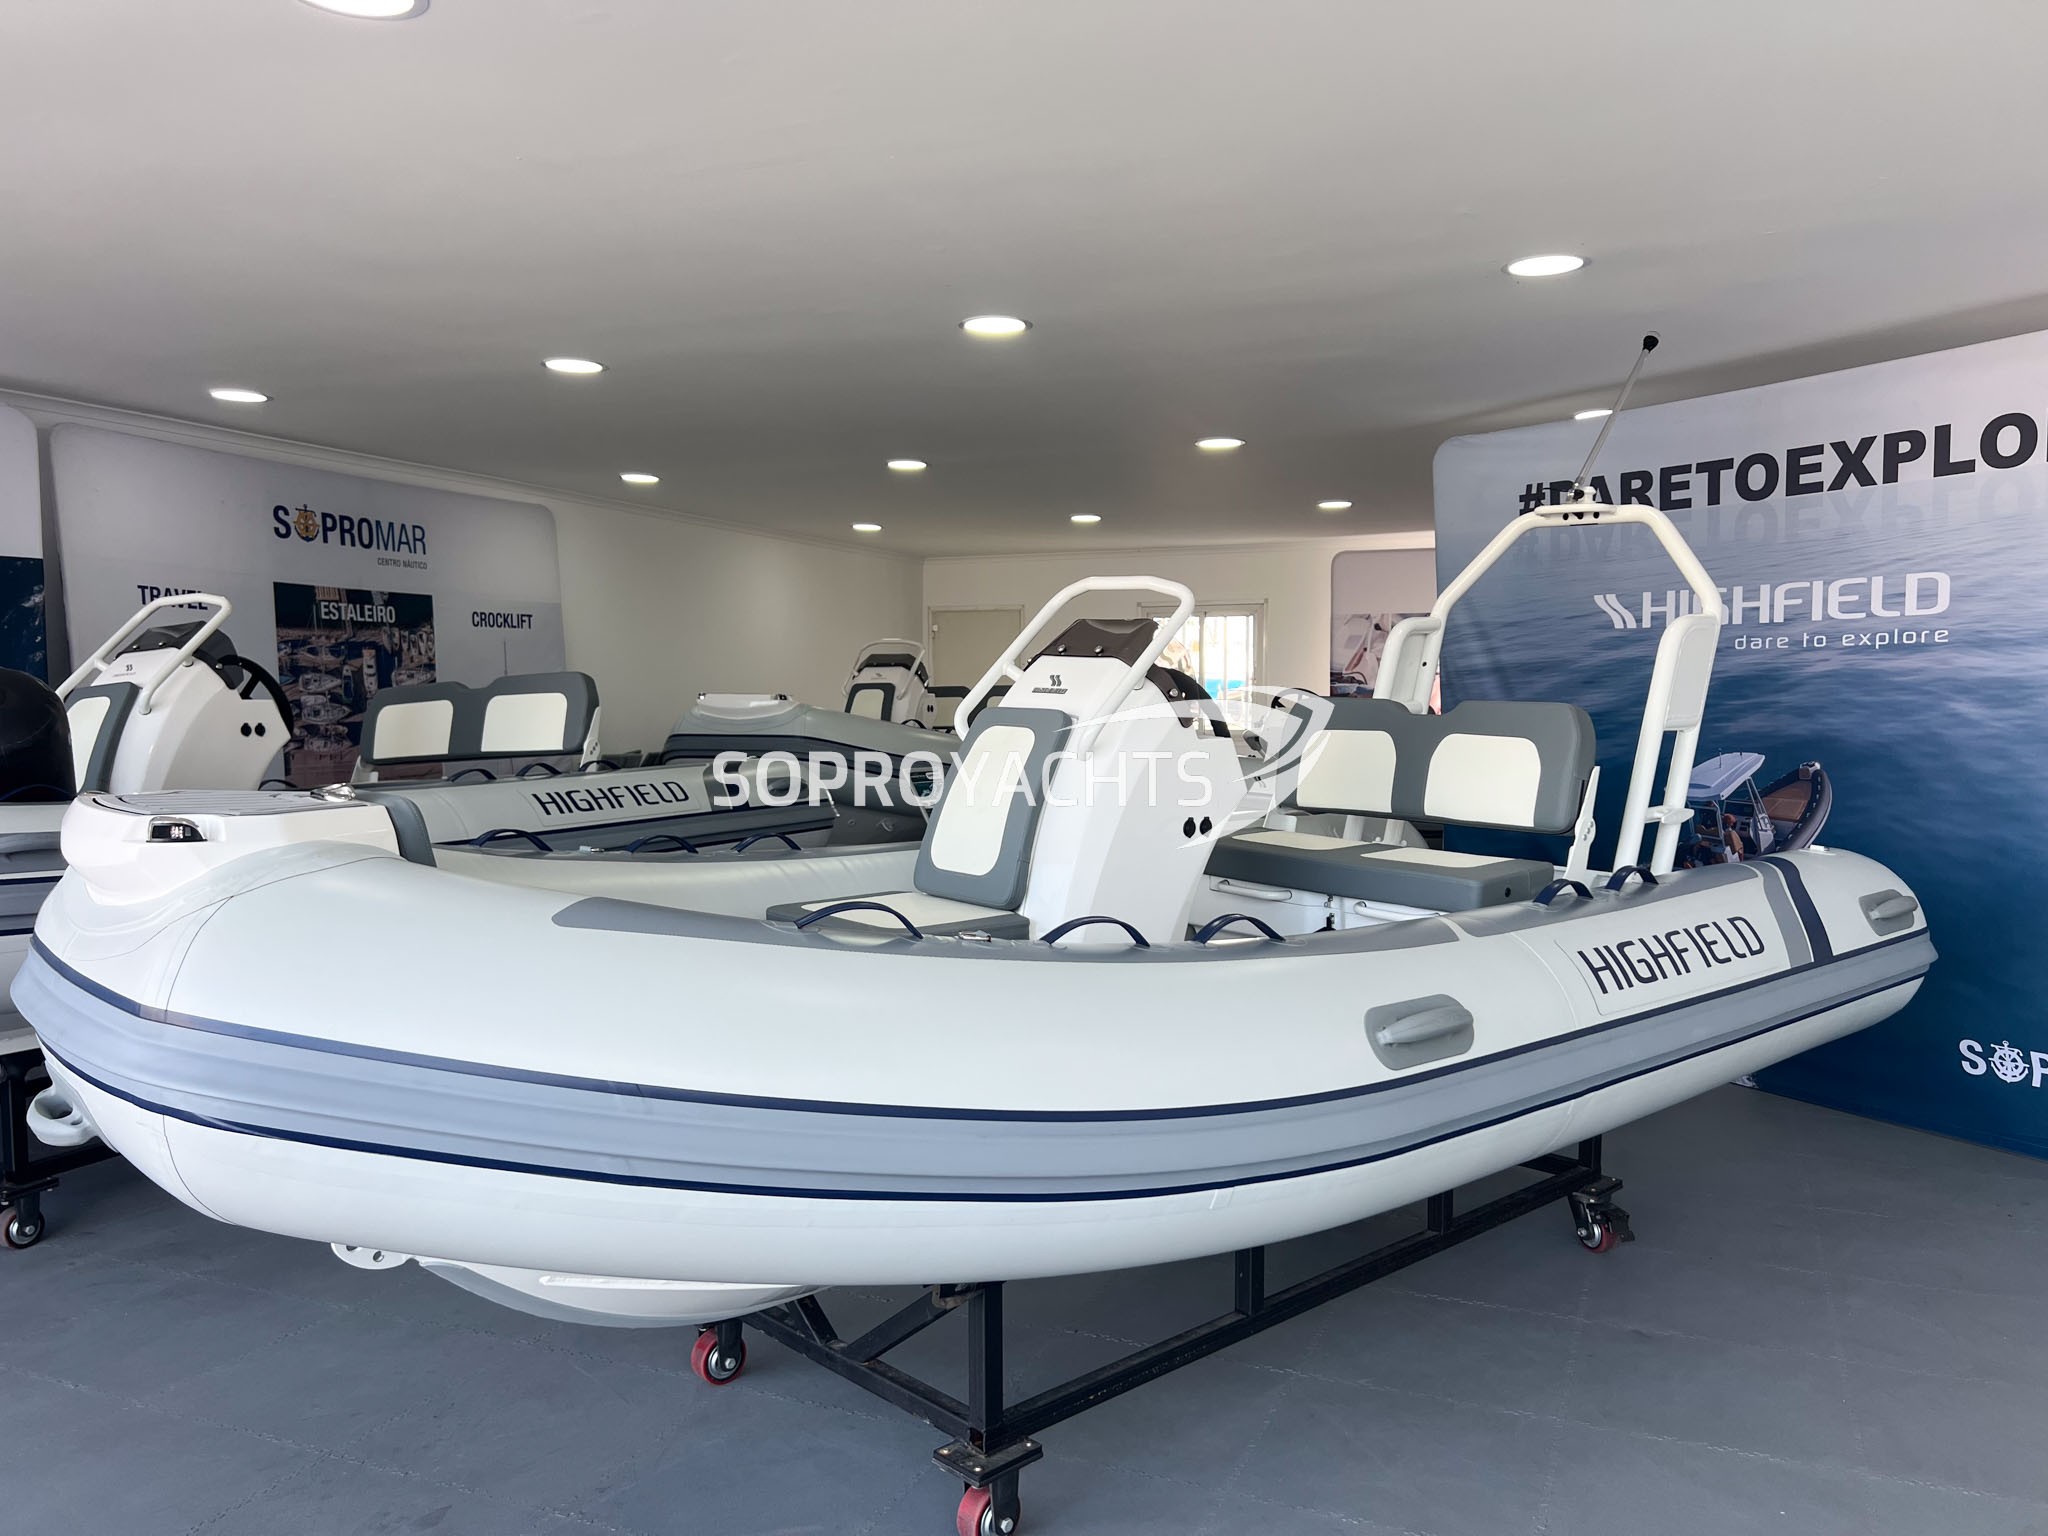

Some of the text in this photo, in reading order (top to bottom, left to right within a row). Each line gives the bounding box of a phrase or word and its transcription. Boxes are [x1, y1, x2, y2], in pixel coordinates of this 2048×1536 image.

[1519, 412, 2048, 515] #DARETOEXPLO
[377, 557, 401, 568] CENTRO
[320, 602, 396, 624] ESTALEIRO
[471, 611, 533, 630] CROCKLIFT
[1734, 628, 1950, 650] dare to explore
[532, 781, 690, 816] HIGHFIELD
[1577, 916, 1766, 995] HIGHFIELD
